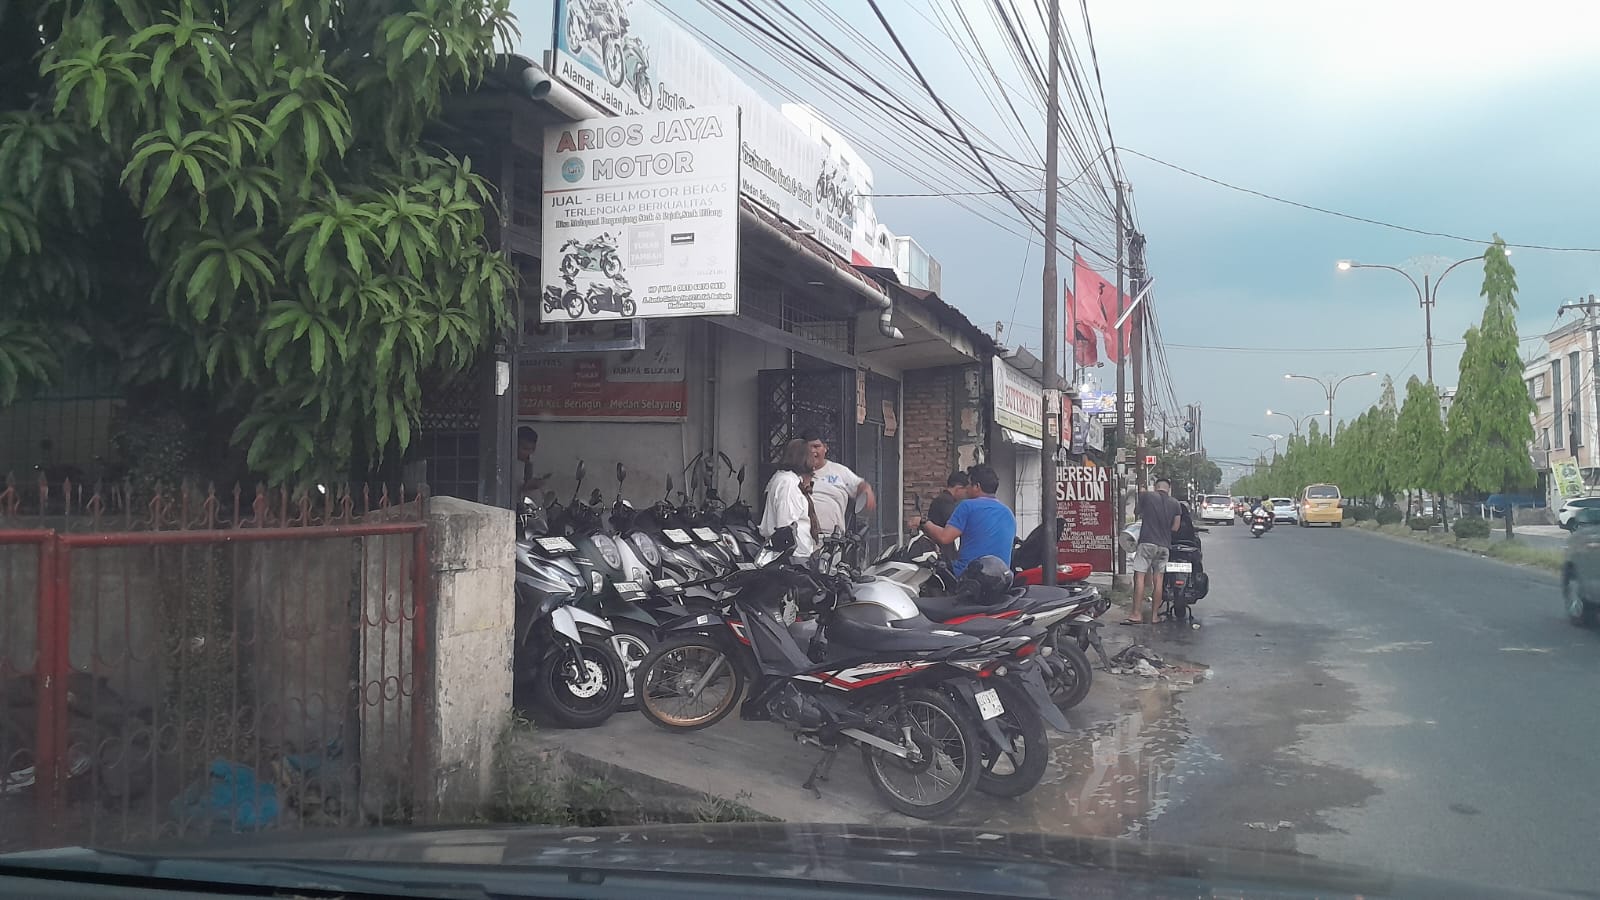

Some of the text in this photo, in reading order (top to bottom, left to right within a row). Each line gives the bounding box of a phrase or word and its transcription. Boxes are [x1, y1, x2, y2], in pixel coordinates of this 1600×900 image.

[563, 61, 594, 93] Alamat
[602, 88, 622, 112] Jalan
[556, 116, 723, 152] ARIOS JAYA
[592, 151, 694, 181] MOTOR
[552, 194, 582, 208] JUAL
[596, 191, 624, 204] BELI
[628, 186, 678, 201] MOTOR
[683, 182, 727, 196] BEKAS
[564, 198, 713, 217] TERLENGKAP BERKUALITAS
[644, 367, 680, 375] SUZUKI
[564, 400, 600, 412] Beringin
[610, 400, 639, 409] Medan
[642, 400, 682, 411] Selayang
[1056, 466, 1108, 482] HERESIA
[1056, 481, 1105, 501] SALON
